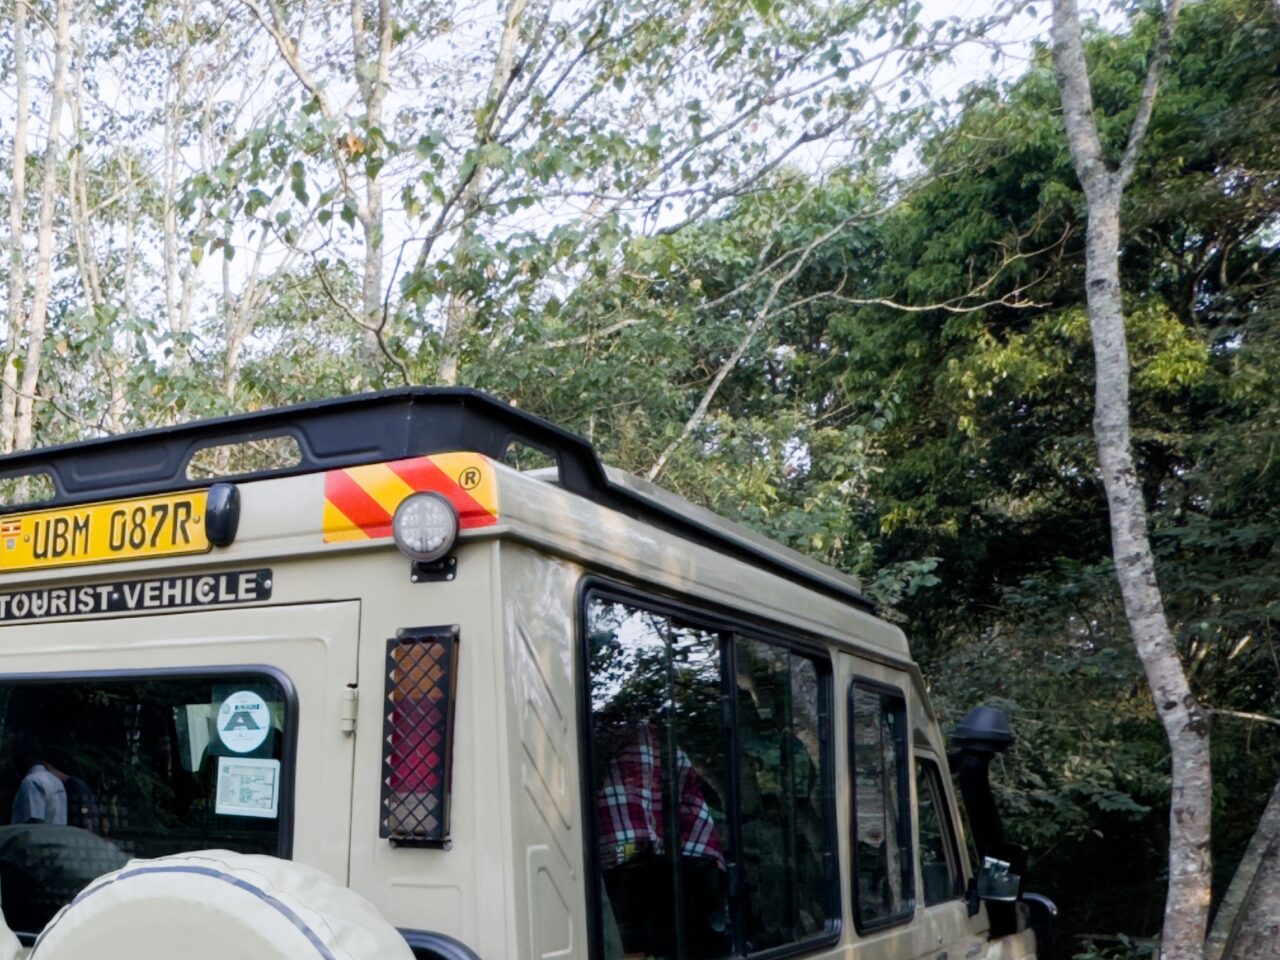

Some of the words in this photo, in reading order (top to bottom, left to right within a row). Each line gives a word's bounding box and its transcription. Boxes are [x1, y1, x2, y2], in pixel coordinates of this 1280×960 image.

[32, 513, 91, 560] UBM
[108, 500, 192, 551] 087R
[122, 572, 258, 609] VEHICLE
